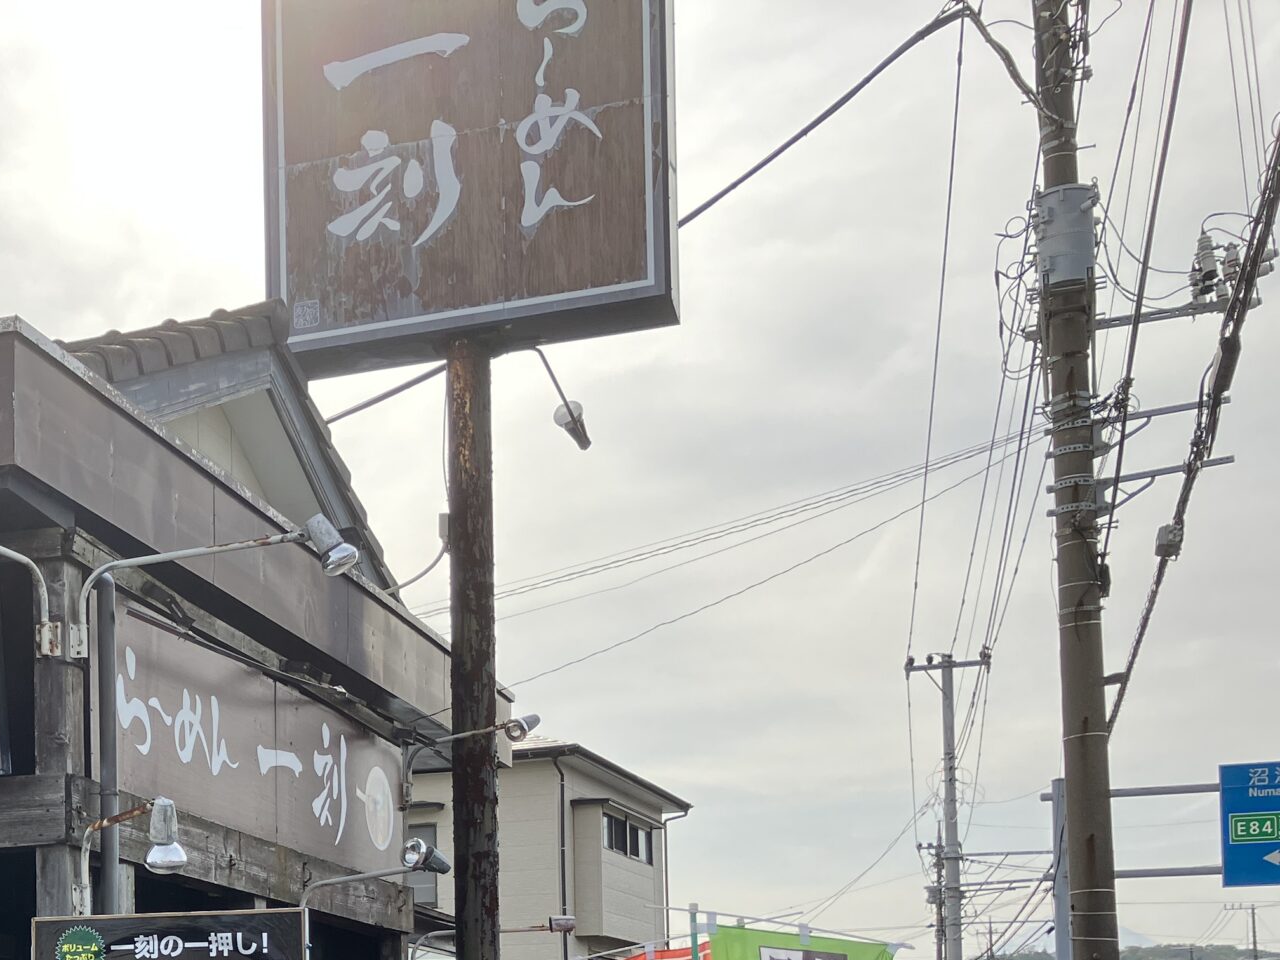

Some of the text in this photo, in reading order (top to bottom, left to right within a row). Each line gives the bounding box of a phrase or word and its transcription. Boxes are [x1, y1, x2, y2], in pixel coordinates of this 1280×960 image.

[323, 32, 470, 247] 一刻
[256, 722, 347, 846] 一刻
[1249, 767, 1280, 786] 沼
[61, 943, 98, 955] ボリューム
